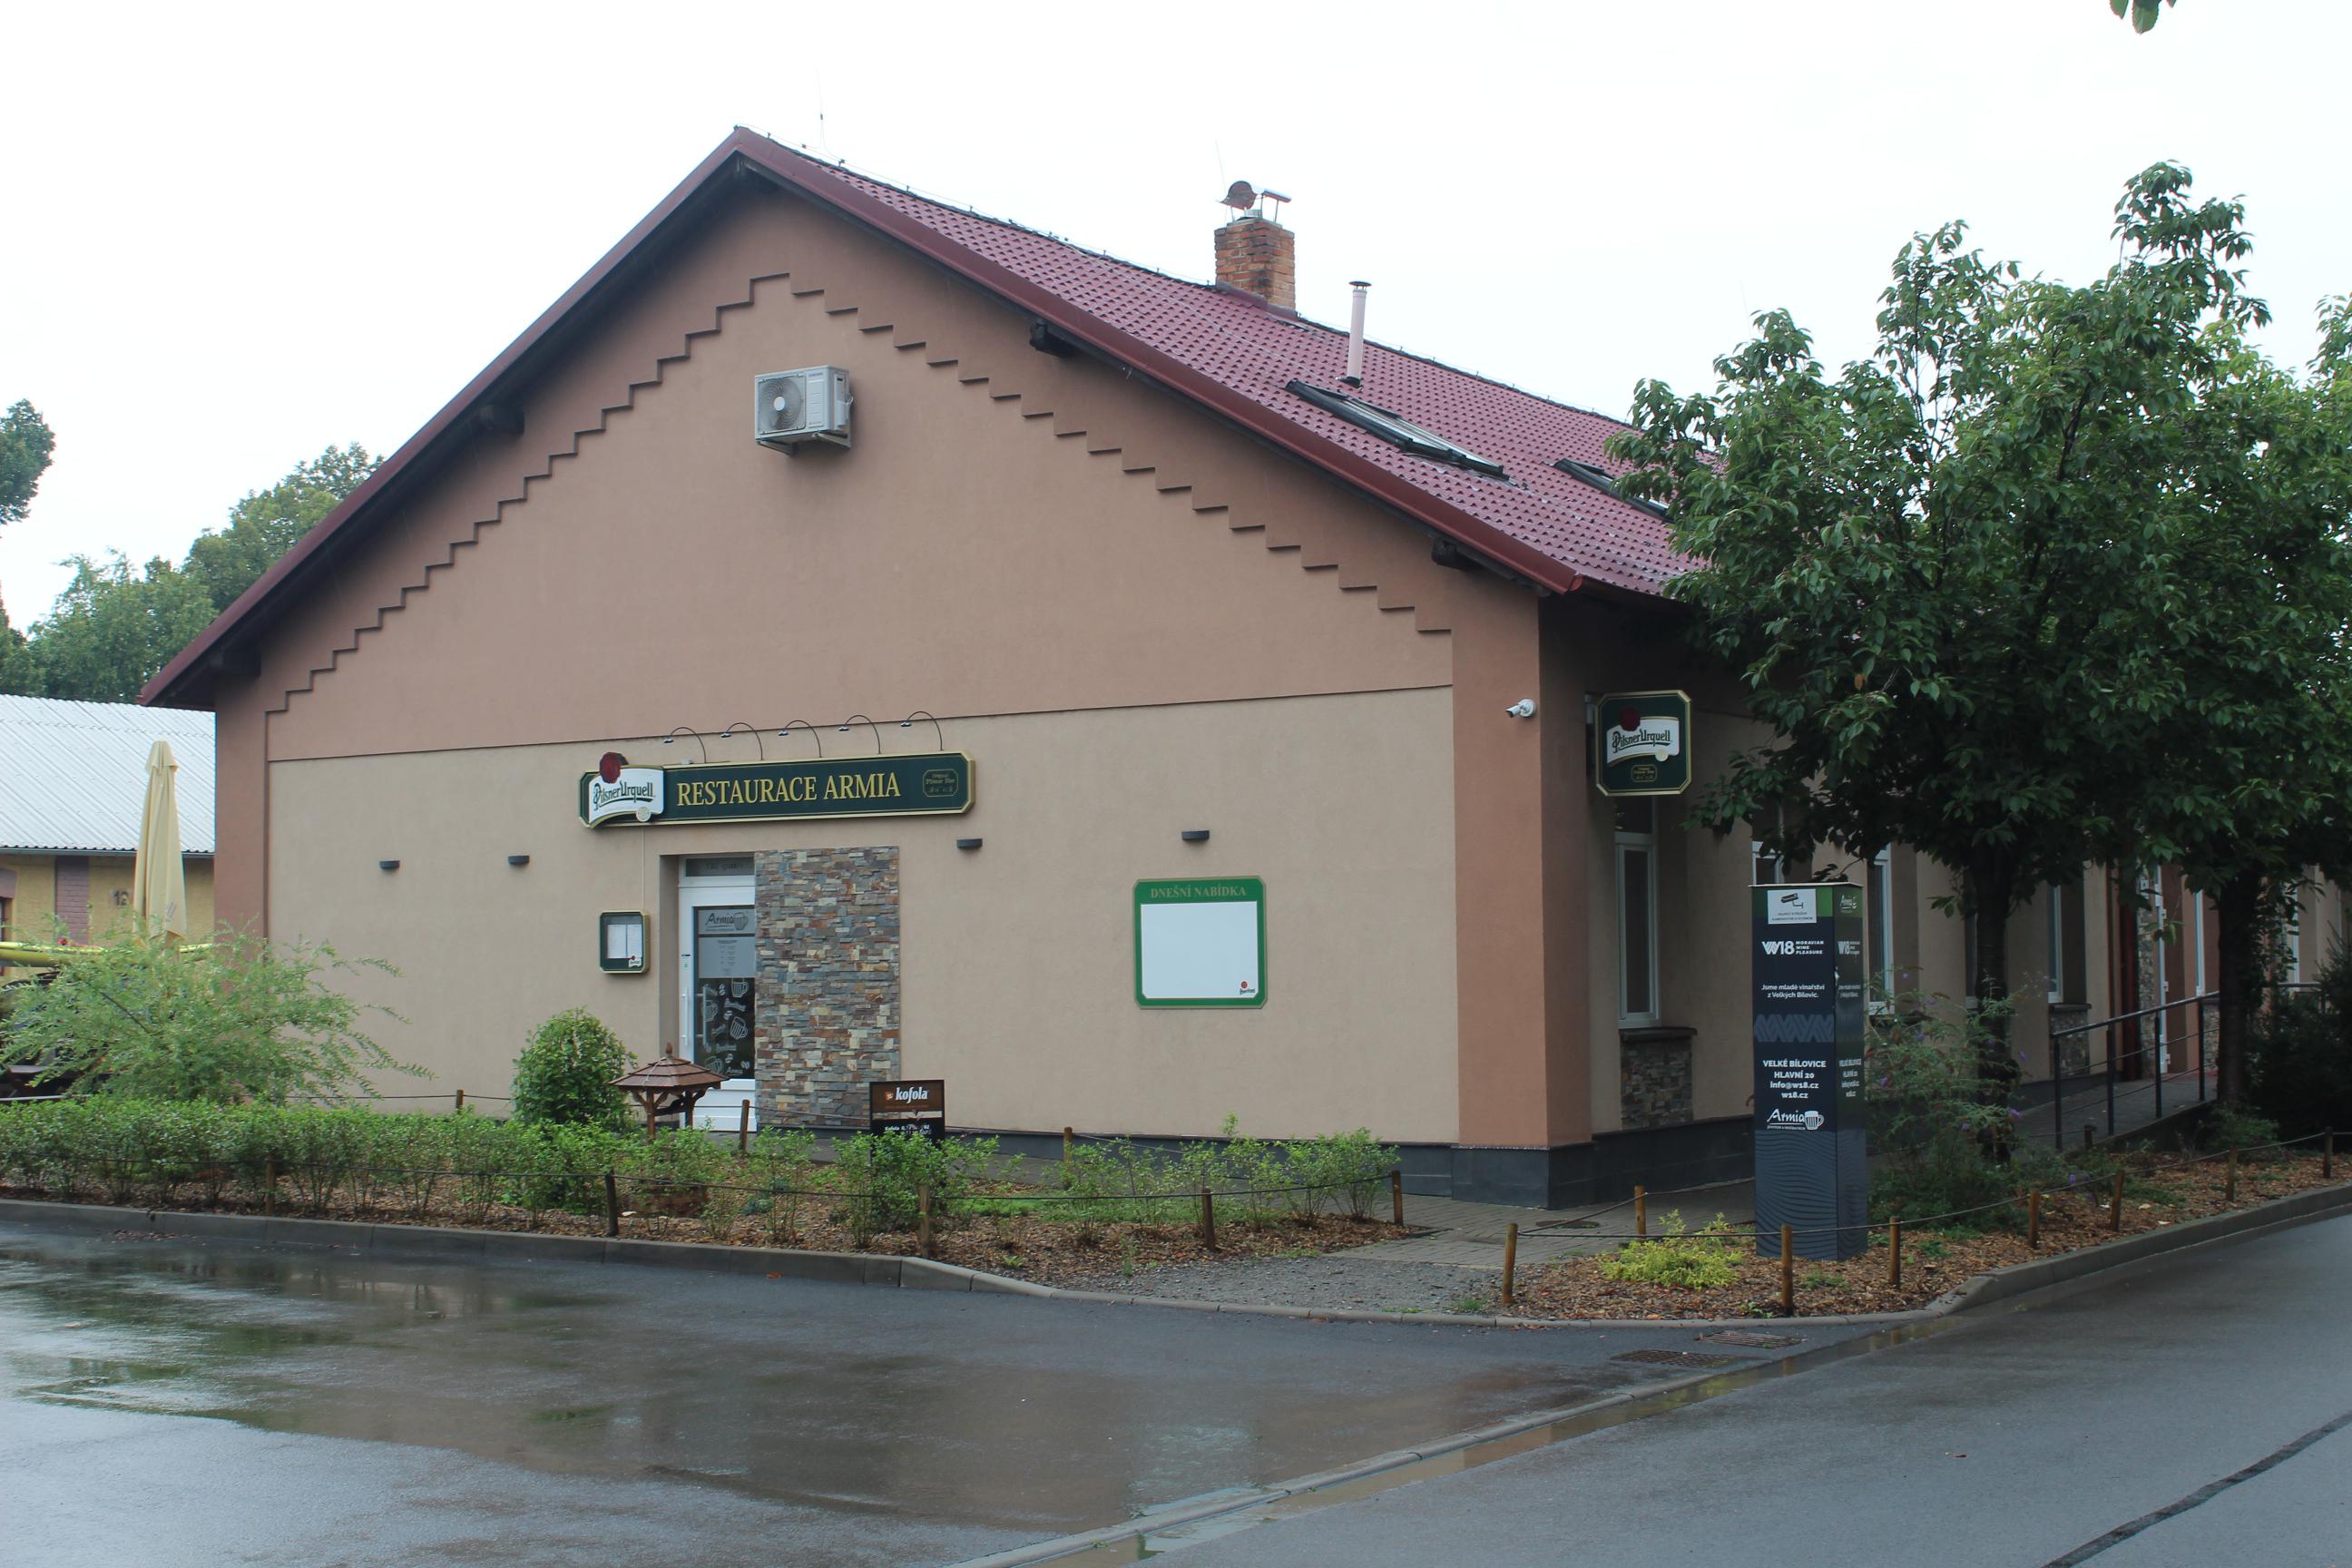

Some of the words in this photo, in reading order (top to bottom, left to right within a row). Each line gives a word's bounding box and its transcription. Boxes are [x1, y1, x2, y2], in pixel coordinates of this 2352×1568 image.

[1612, 730, 1641, 753] Pilsner
[1640, 729, 1671, 747] Urquell
[593, 782, 620, 811] Pilsner
[619, 780, 652, 803] Urquell
[676, 776, 818, 807] RESTAURACE
[824, 772, 901, 800] ARMIA
[1194, 883, 1247, 897] NABÍDKA
[1762, 1058, 1788, 1067] VELKÉ
[1789, 1058, 1827, 1068] BÍLOVICE
[1774, 1070, 1803, 1079] HLAVNÍ
[1770, 1081, 1819, 1090] info@w18.cz
[895, 1086, 928, 1103] kofola
[1767, 1108, 1806, 1123] Armia
